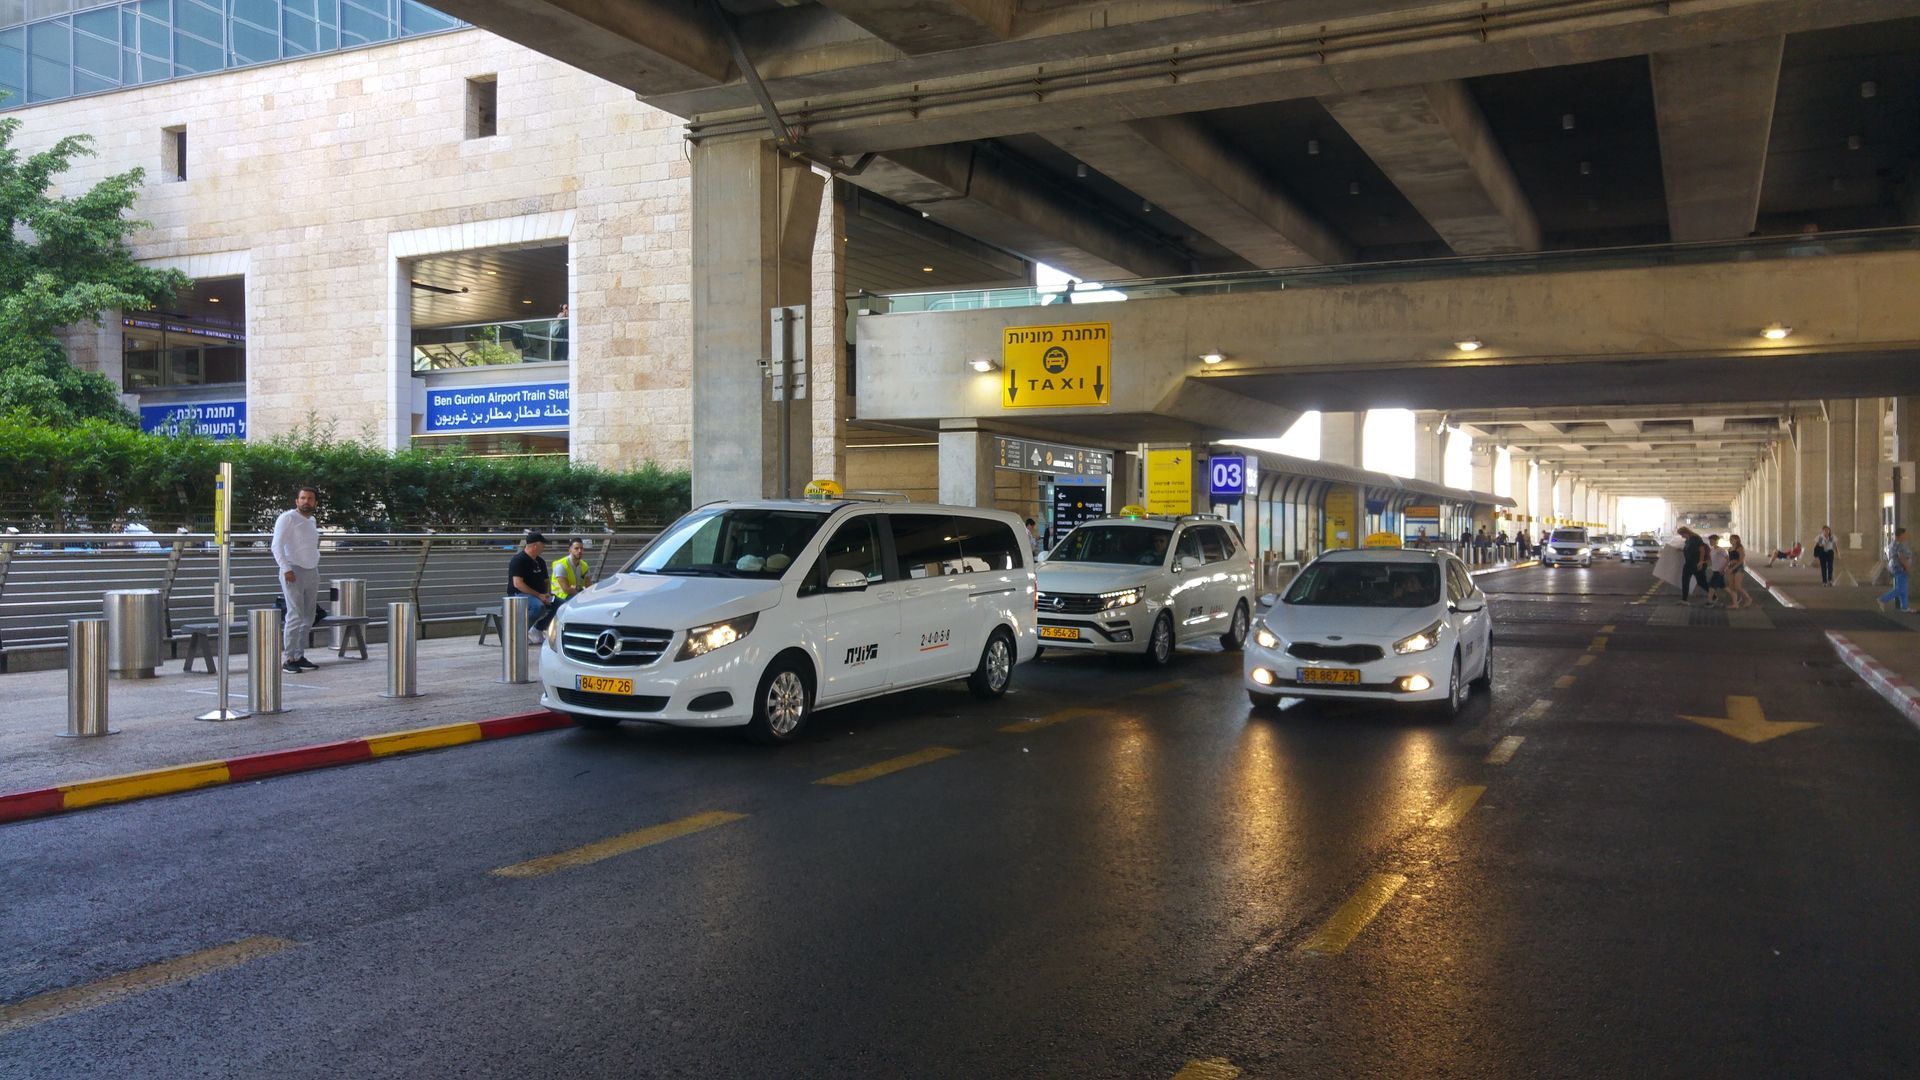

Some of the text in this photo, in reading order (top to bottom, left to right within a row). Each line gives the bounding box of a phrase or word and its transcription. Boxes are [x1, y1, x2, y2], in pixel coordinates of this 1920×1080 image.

[1008, 328, 1106, 344] תחנת מוניות
[1028, 378, 1084, 390] TAXI
[434, 396, 452, 406] Ben
[454, 394, 486, 405] Gurion
[488, 391, 520, 404] Airport
[522, 390, 546, 400] Train
[206, 406, 234, 418] תחנת
[1214, 464, 1241, 487] 03
